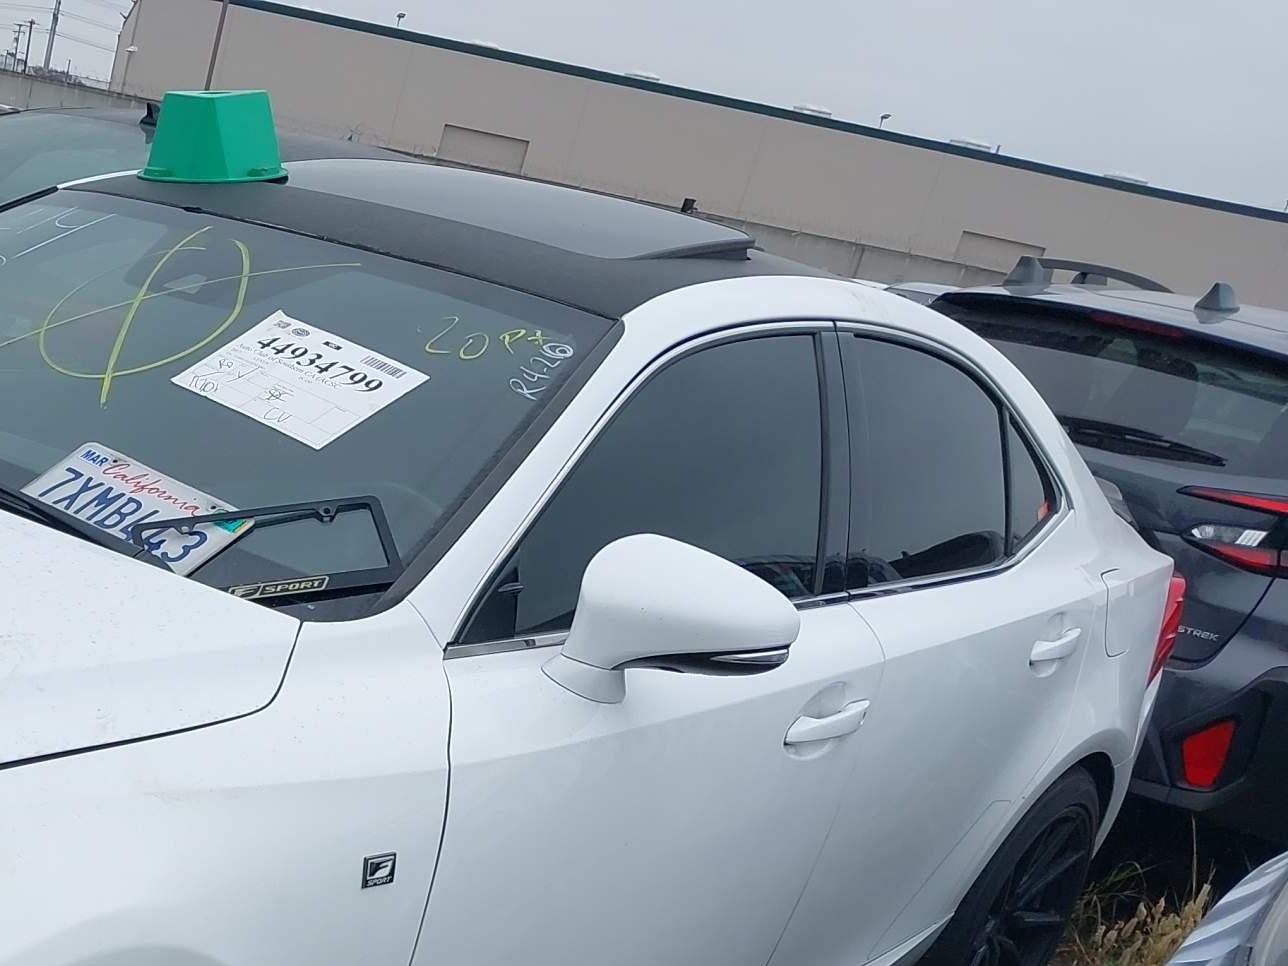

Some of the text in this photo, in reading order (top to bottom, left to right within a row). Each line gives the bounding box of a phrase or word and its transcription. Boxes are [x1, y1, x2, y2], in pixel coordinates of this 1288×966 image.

[425, 316, 490, 360] 20
[257, 336, 384, 394] 44934799
[79, 449, 204, 518] MAR California
[263, 579, 323, 594] SPORT
